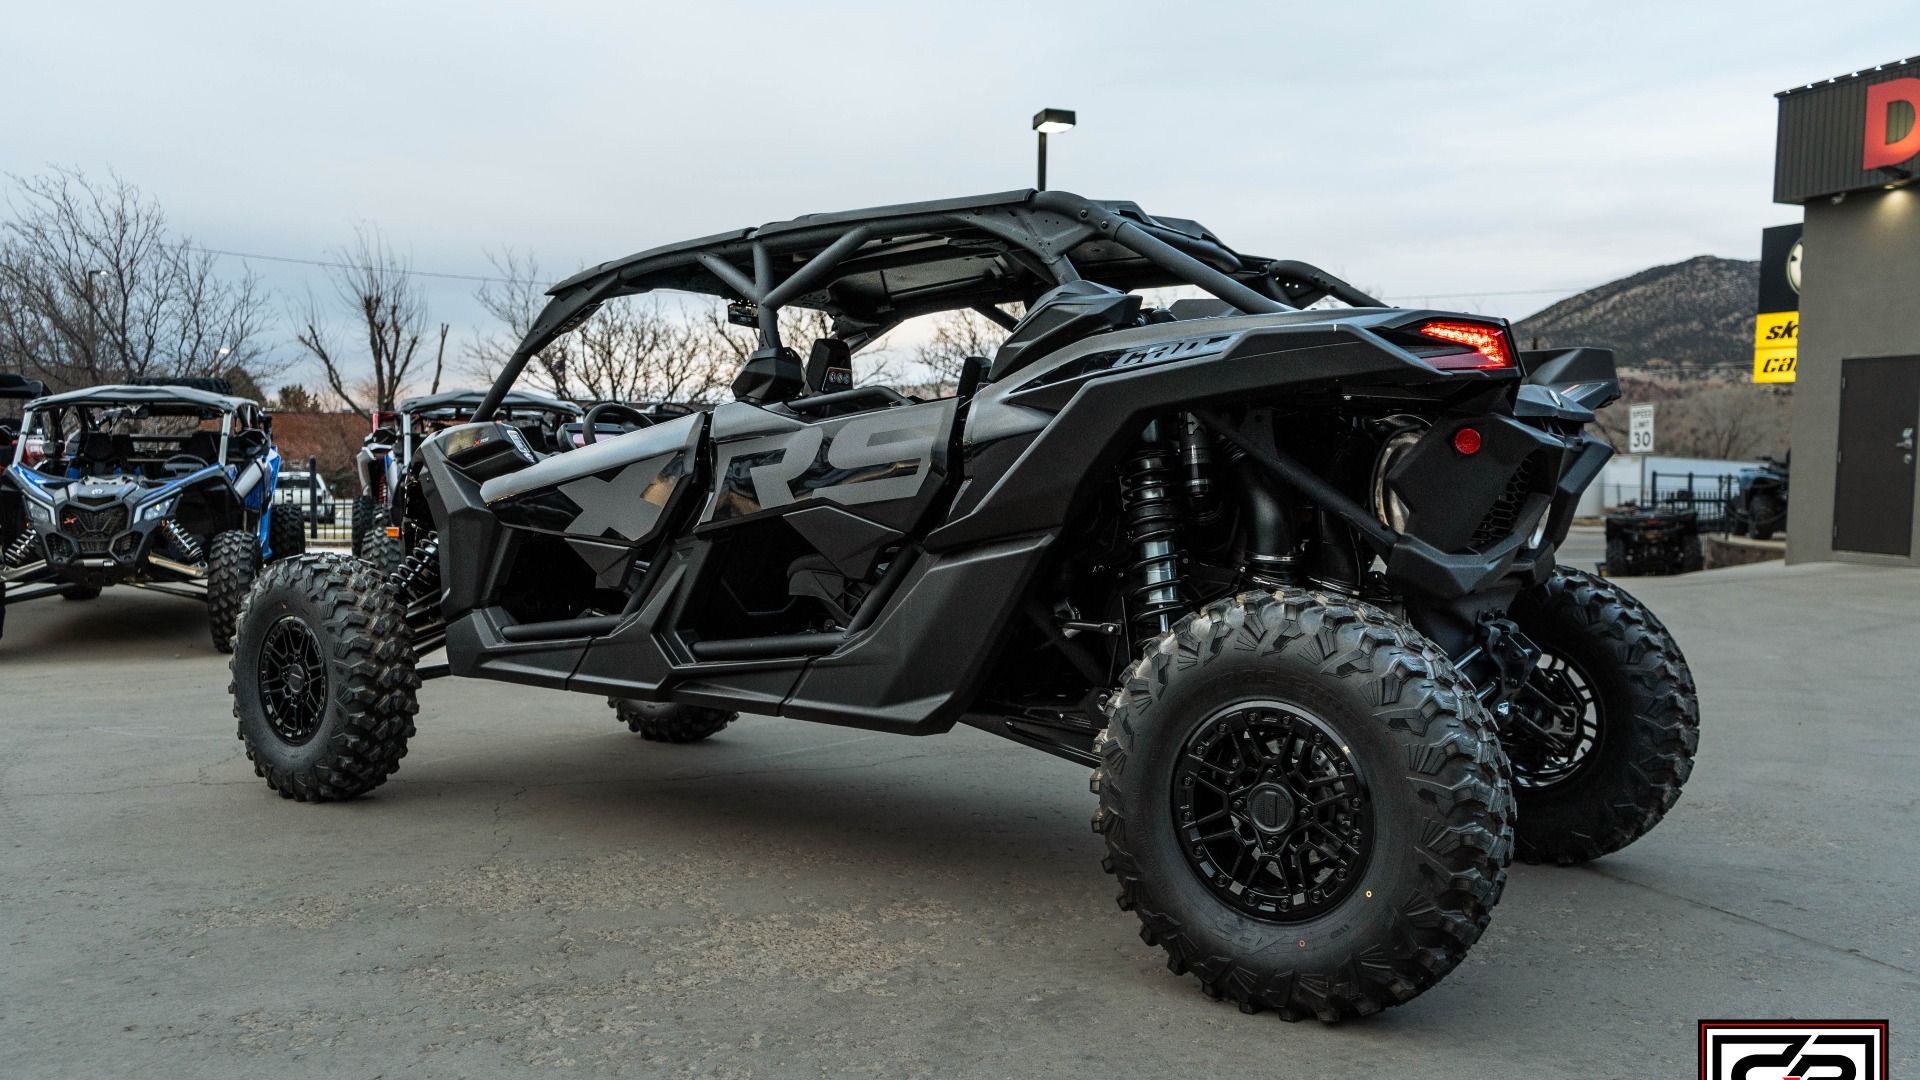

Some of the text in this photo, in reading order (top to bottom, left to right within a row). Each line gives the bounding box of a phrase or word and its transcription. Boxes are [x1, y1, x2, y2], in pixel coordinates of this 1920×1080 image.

[1766, 321, 1798, 339] sk
[1763, 357, 1796, 372] ca
[1633, 431, 1651, 448] 30
